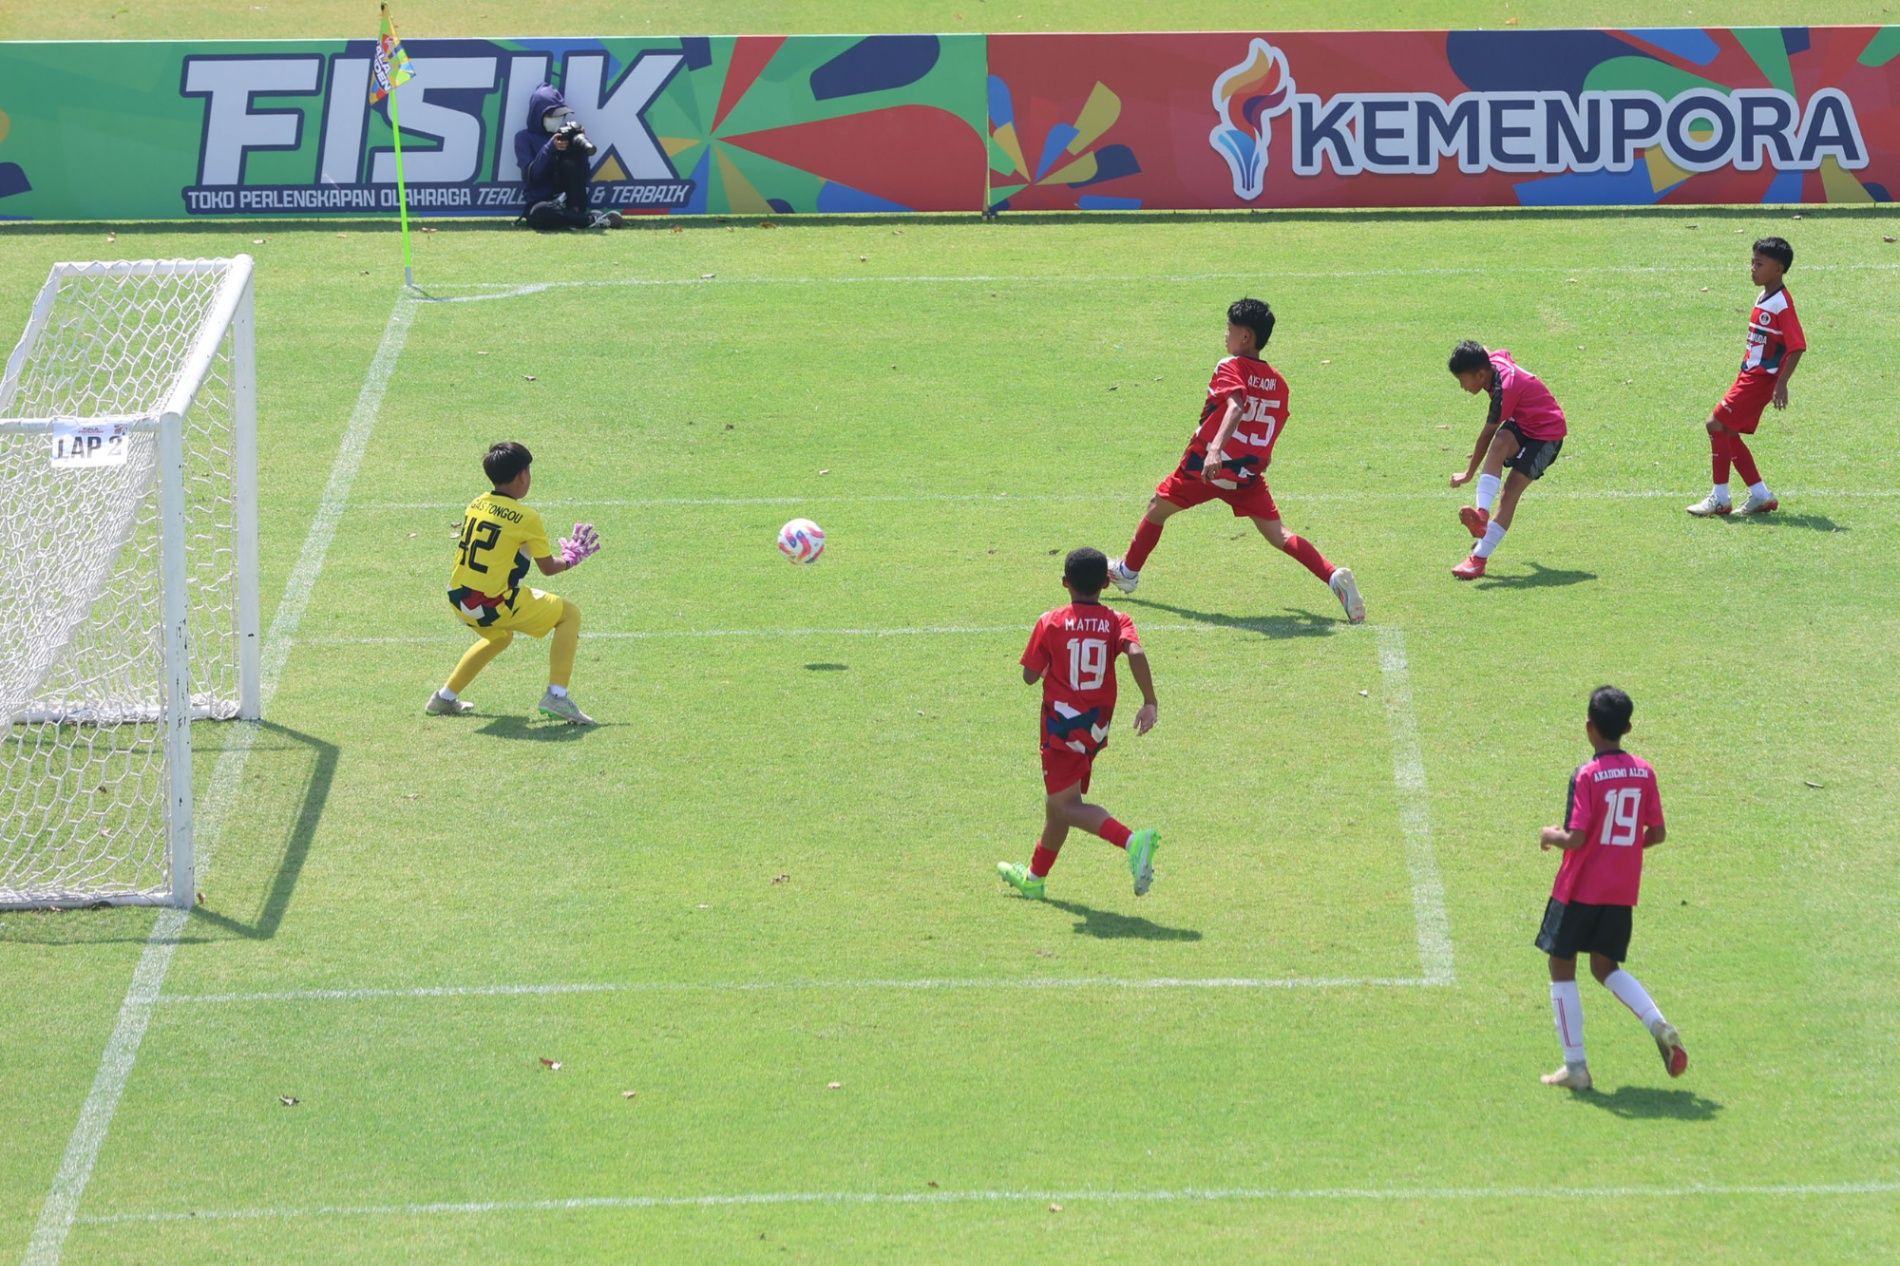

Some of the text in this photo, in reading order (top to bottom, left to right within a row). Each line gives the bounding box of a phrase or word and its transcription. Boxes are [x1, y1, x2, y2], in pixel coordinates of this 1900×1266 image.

[183, 53, 686, 186] FISIK
[1298, 95, 1862, 168] KEMENPORA
[187, 191, 235, 209] TOKO
[239, 189, 376, 208] PERLENGKAPAN
[380, 187, 472, 207] OLAHRAGA
[590, 186, 606, 204] &
[611, 184, 690, 203] TERBAIK
[57, 435, 123, 459] LAP 2
[1231, 394, 1281, 447] 25
[458, 515, 503, 574] 42
[1066, 637, 1108, 692] 19
[1600, 787, 1642, 847] 19
